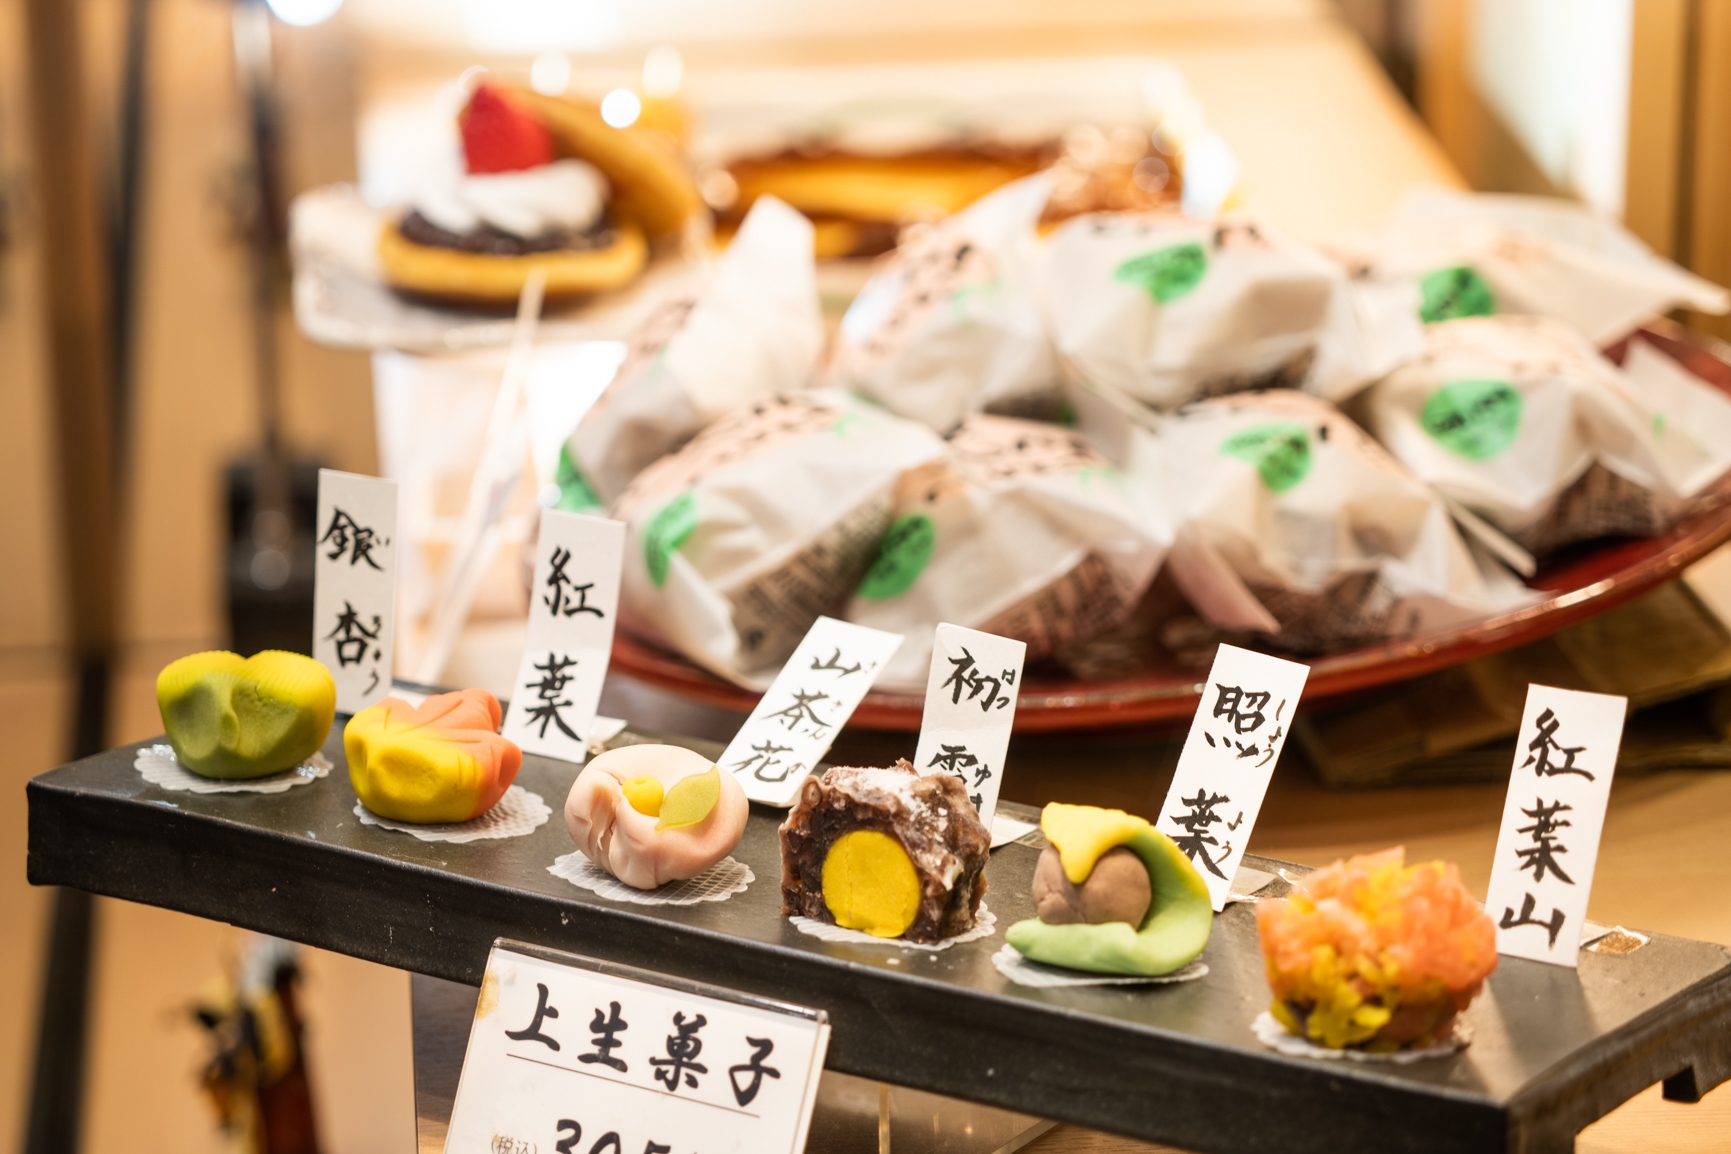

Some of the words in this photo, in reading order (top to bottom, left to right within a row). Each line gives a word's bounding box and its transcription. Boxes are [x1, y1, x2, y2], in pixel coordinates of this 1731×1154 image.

[316, 505, 385, 668] 銀杏
[524, 545, 605, 742] 紅葉
[727, 647, 862, 783] 山茶花
[1165, 683, 1272, 882] 照葉
[1498, 707, 1596, 952] 紅葉山
[504, 982, 781, 1107] 上生菓子
